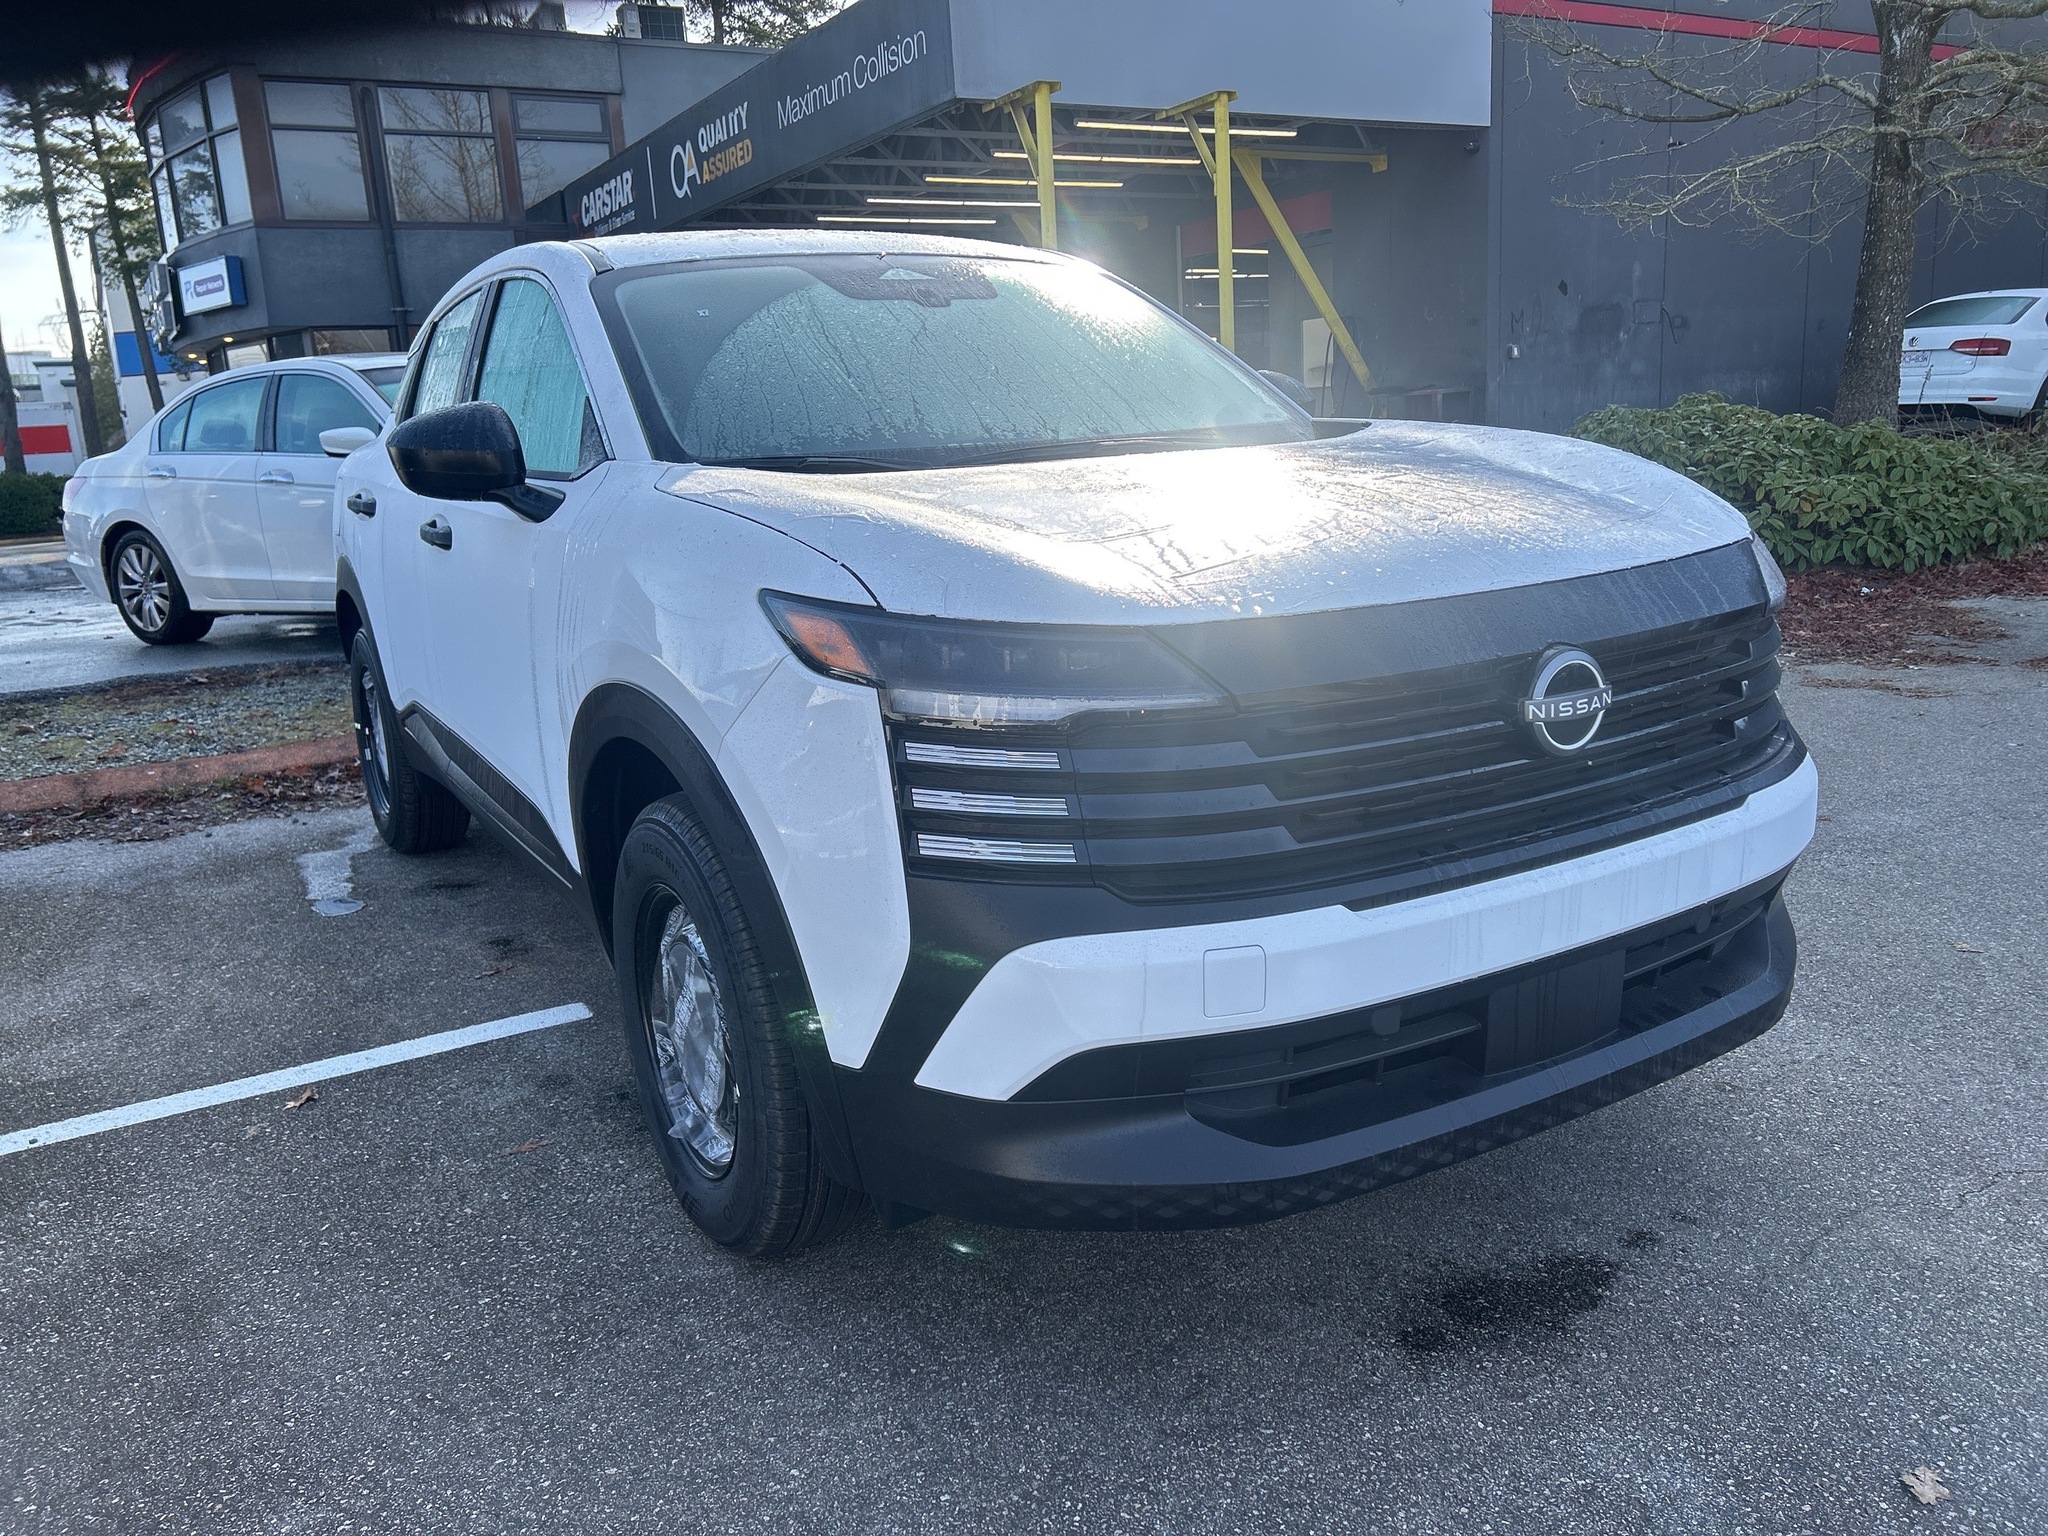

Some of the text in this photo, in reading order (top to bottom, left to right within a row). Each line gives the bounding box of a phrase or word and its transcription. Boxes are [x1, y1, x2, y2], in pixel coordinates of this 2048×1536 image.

[777, 30, 927, 130] Maximum Collision
[703, 139, 753, 184] ASSURED
[581, 170, 633, 227] CARSTAR
[1528, 689, 1612, 719] NISSAN
